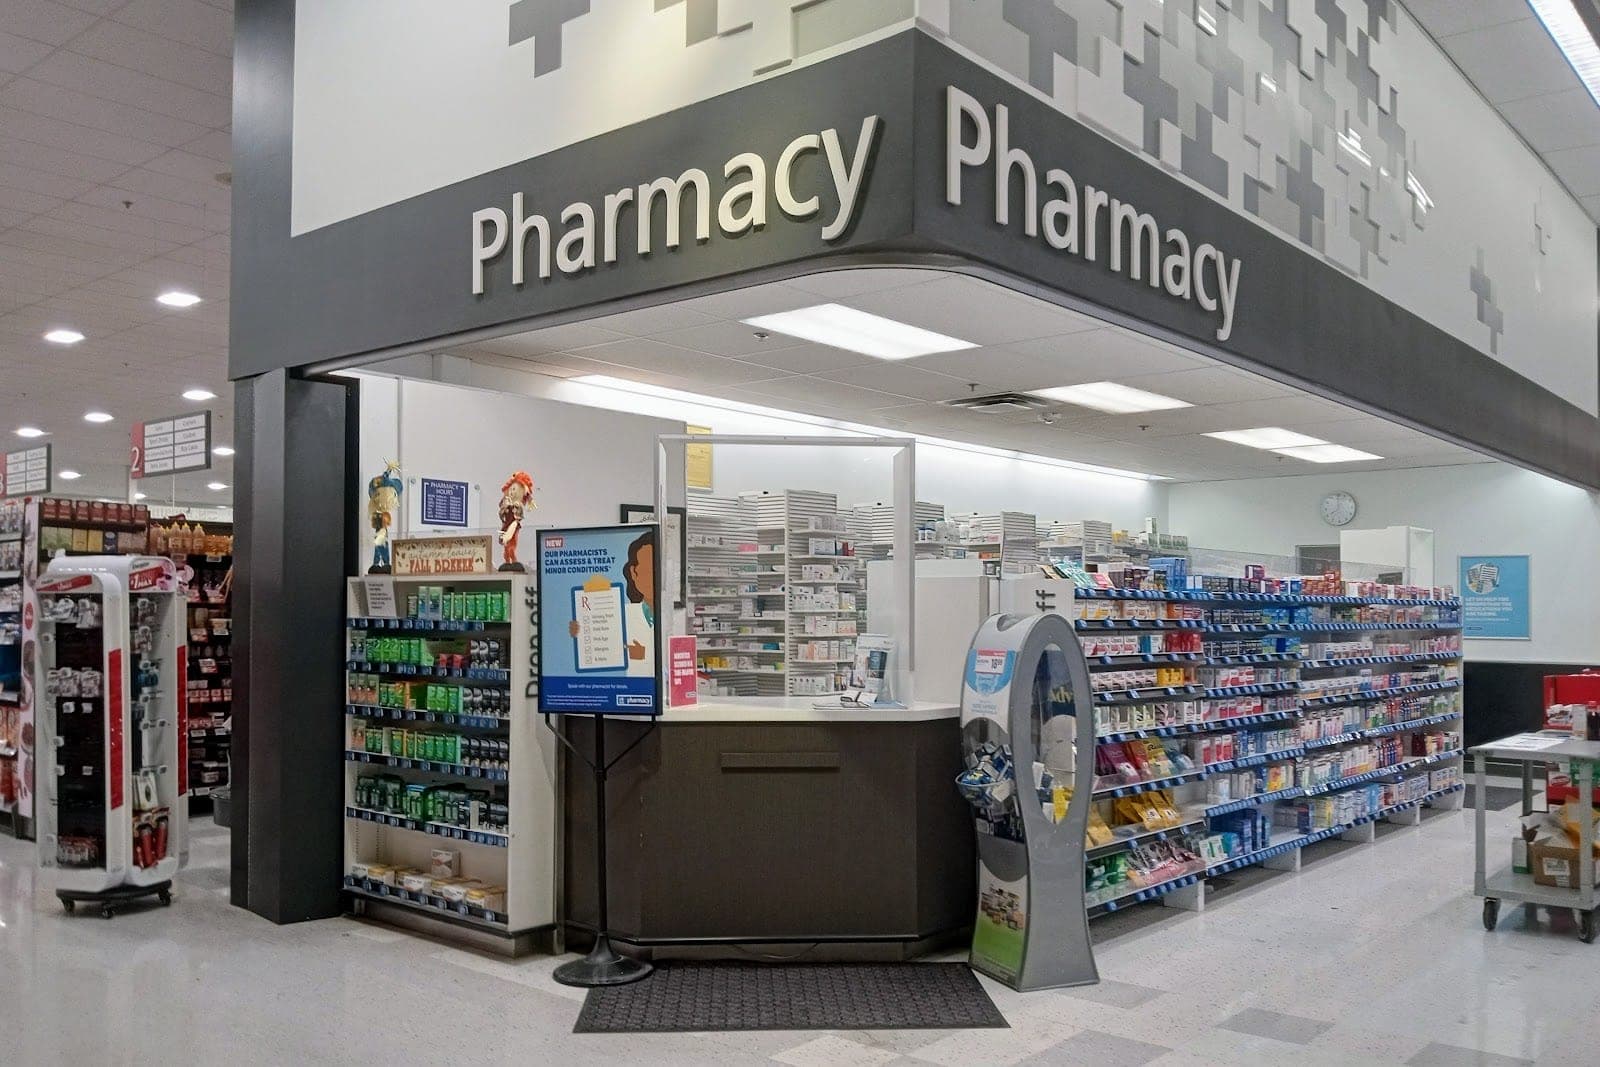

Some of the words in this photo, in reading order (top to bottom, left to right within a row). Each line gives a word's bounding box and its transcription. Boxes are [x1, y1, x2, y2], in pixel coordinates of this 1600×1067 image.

[472, 114, 879, 295] Pharmacy
[947, 84, 1241, 341] Pharmacy
[131, 446, 140, 472] 2
[545, 539, 563, 548] NEW
[559, 549, 608, 557] PHARMACISTS
[409, 558, 432, 574] FALL
[560, 558, 586, 566] ASSESS
[593, 557, 616, 565] TREAT
[545, 567, 567, 575] MINOR
[1035, 589, 1056, 612] ff
